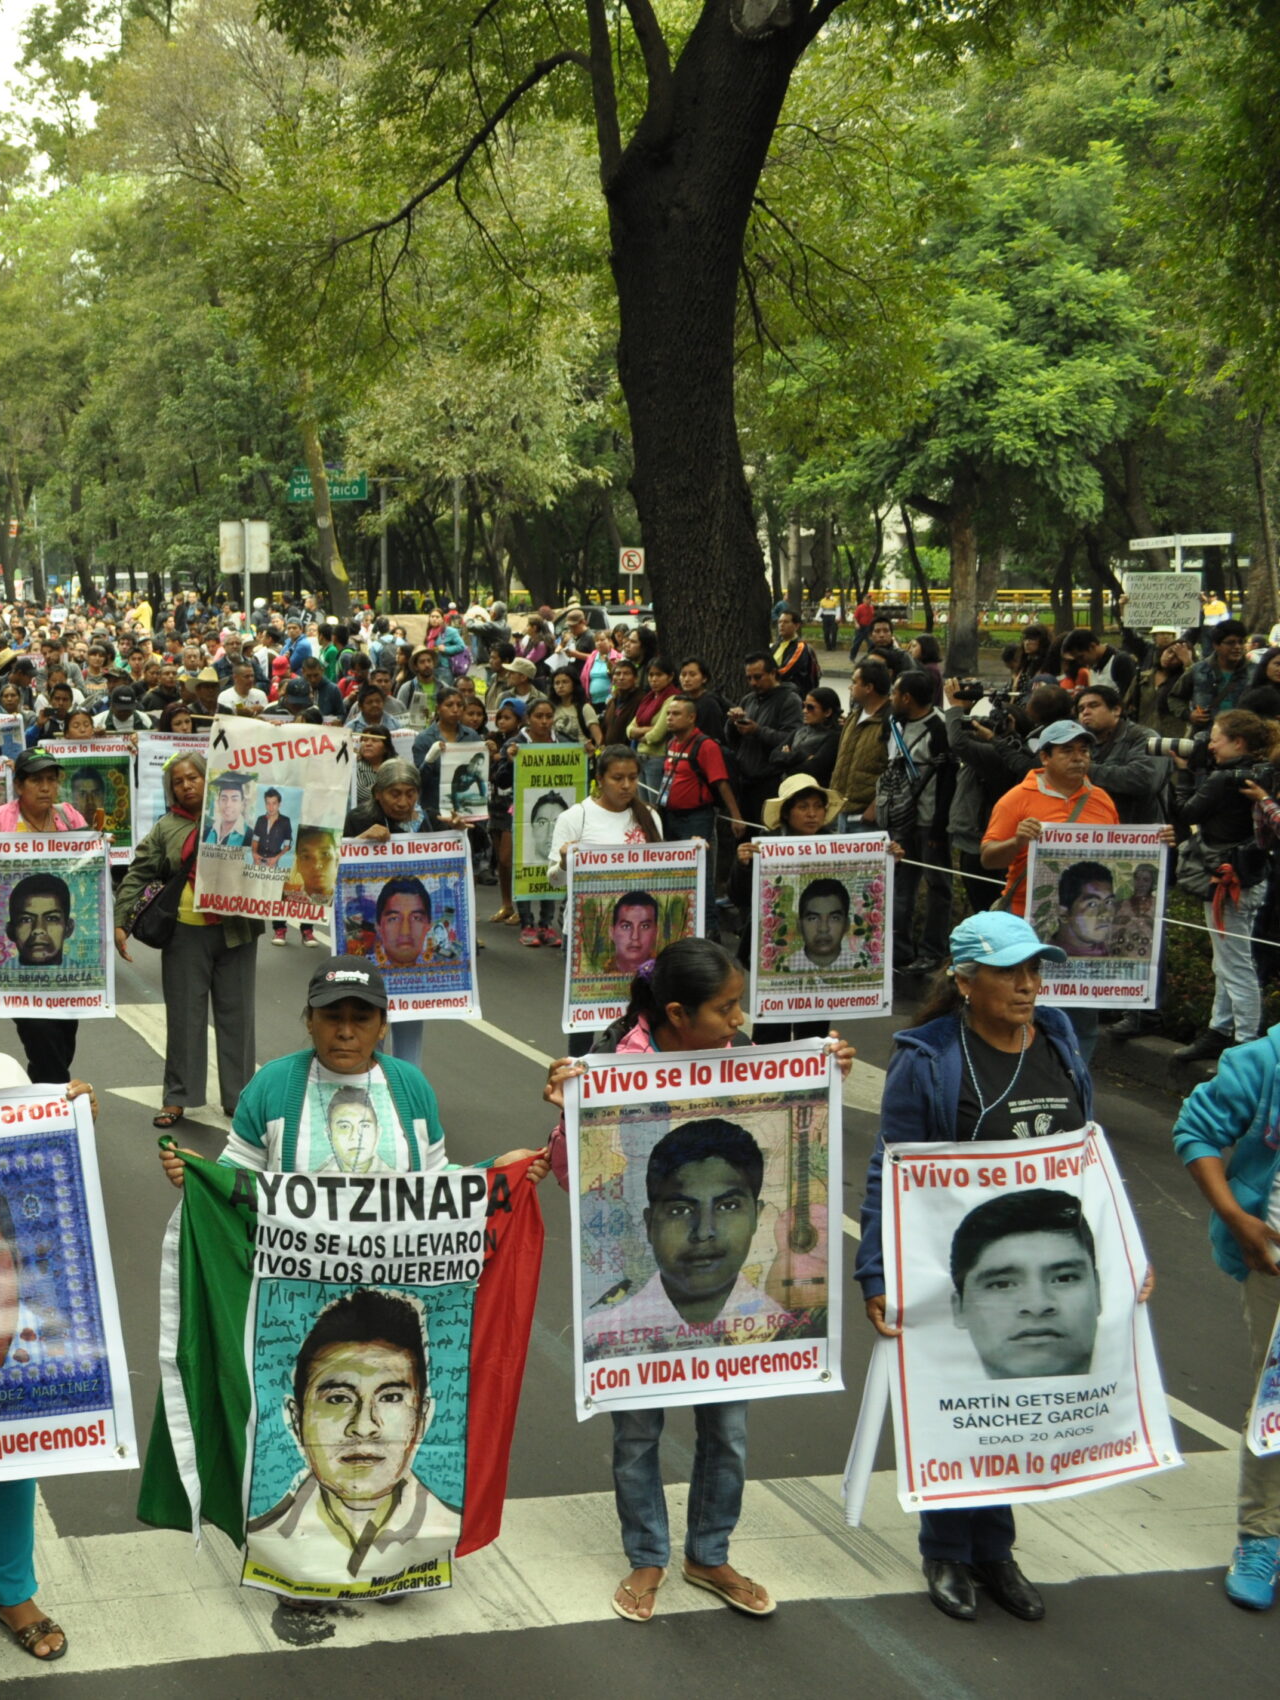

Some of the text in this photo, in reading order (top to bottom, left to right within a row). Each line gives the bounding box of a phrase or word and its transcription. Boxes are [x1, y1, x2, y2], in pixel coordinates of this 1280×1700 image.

[228, 735, 336, 770] JUSTICIA
[531, 774, 573, 787] DE LA CRUZ
[15, 842, 29, 852] se
[32, 840, 44, 852] lo
[48, 840, 103, 852] llevaron!
[761, 841, 884, 859] ¡Vivo se lo llevaron!
[1039, 830, 1160, 844] ¡Vivo se lo llevaron!
[245, 864, 267, 873] JULIO
[575, 848, 697, 866] ¡Vivo se lo llevaron!
[200, 893, 324, 920] MASACRADOS EN IGUALA
[583, 1053, 826, 1098] ¡Vivo se lo llevaron!
[903, 1161, 1037, 1192] ¡Vivo se lo
[230, 1168, 512, 1222] AYOTZINAPA
[245, 1222, 497, 1259] VIVOS SE LOS LLEVARON
[245, 1248, 312, 1278] VIVOS
[320, 1259, 364, 1283] LOS
[596, 1326, 664, 1346] FELIPE
[676, 1316, 755, 1340] ARNULFO
[766, 1311, 814, 1330] ROSA
[590, 1367, 630, 1396] ¡Con
[637, 1358, 686, 1385] VIDA
[691, 1356, 710, 1380] lo
[716, 1346, 819, 1382] queremos!
[939, 1382, 1118, 1411] MARTÍN GETSEMANY
[953, 1403, 1109, 1430] SÁNCHEZ GARCÍA
[979, 1425, 1094, 1446] EDAD 20 AÑOS
[920, 1431, 1139, 1488] ¡Con VIDA lo queremos!
[337, 1585, 389, 1600] Mendoza
